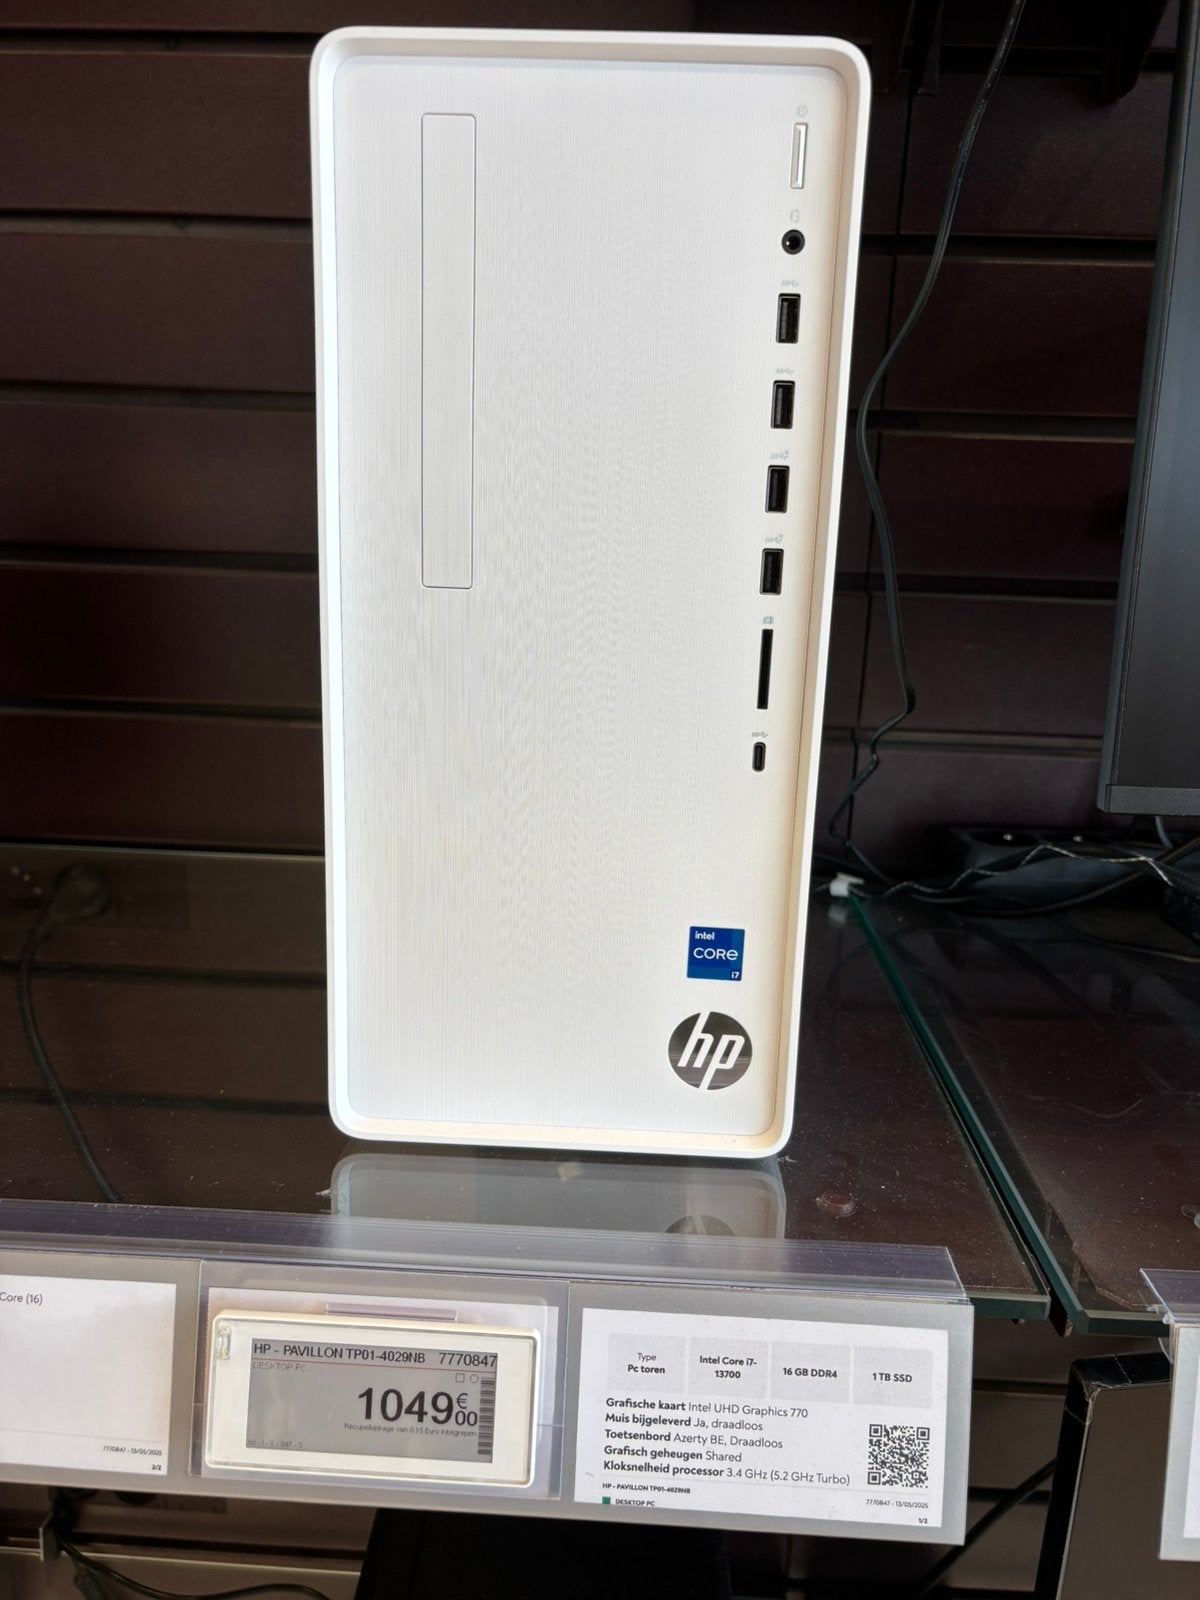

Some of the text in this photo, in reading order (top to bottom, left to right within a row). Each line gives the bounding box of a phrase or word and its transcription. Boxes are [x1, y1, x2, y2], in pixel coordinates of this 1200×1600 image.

[695, 931, 715, 940] intel
[731, 971, 740, 979] i7
[677, 1011, 745, 1090] hp
[0, 1292, 43, 1305] Core (16)
[254, 1343, 271, 1354] HP
[283, 1344, 344, 1359] PAVILLON
[346, 1348, 426, 1364] TP01-4029NB
[438, 1353, 497, 1367] 7770847
[637, 1352, 656, 1362] Type
[700, 1356, 757, 1366] Intel Core i7-
[253, 1361, 293, 1371] DESKTOP
[628, 1365, 665, 1374] Pc toren
[783, 1367, 837, 1378] 16 GB DDR4
[715, 1370, 741, 1379] 13700
[879, 1373, 890, 1381] TB
[893, 1373, 912, 1382] SSD
[357, 1387, 454, 1425] 1049
[606, 1398, 808, 1418] Grafische kaart Intel UHD Graphics 770
[455, 1411, 478, 1426] 00
[605, 1413, 763, 1431] Muis bijgeleverd Ja, draadloos
[605, 1429, 783, 1448] Toetsenbord Azerty BE, Draadloos
[604, 1445, 742, 1462] Grafisch geheugen Shared
[604, 1461, 850, 1485] Kloksnelheid processor 3.4 GHz (5.2 GHz Turbo)
